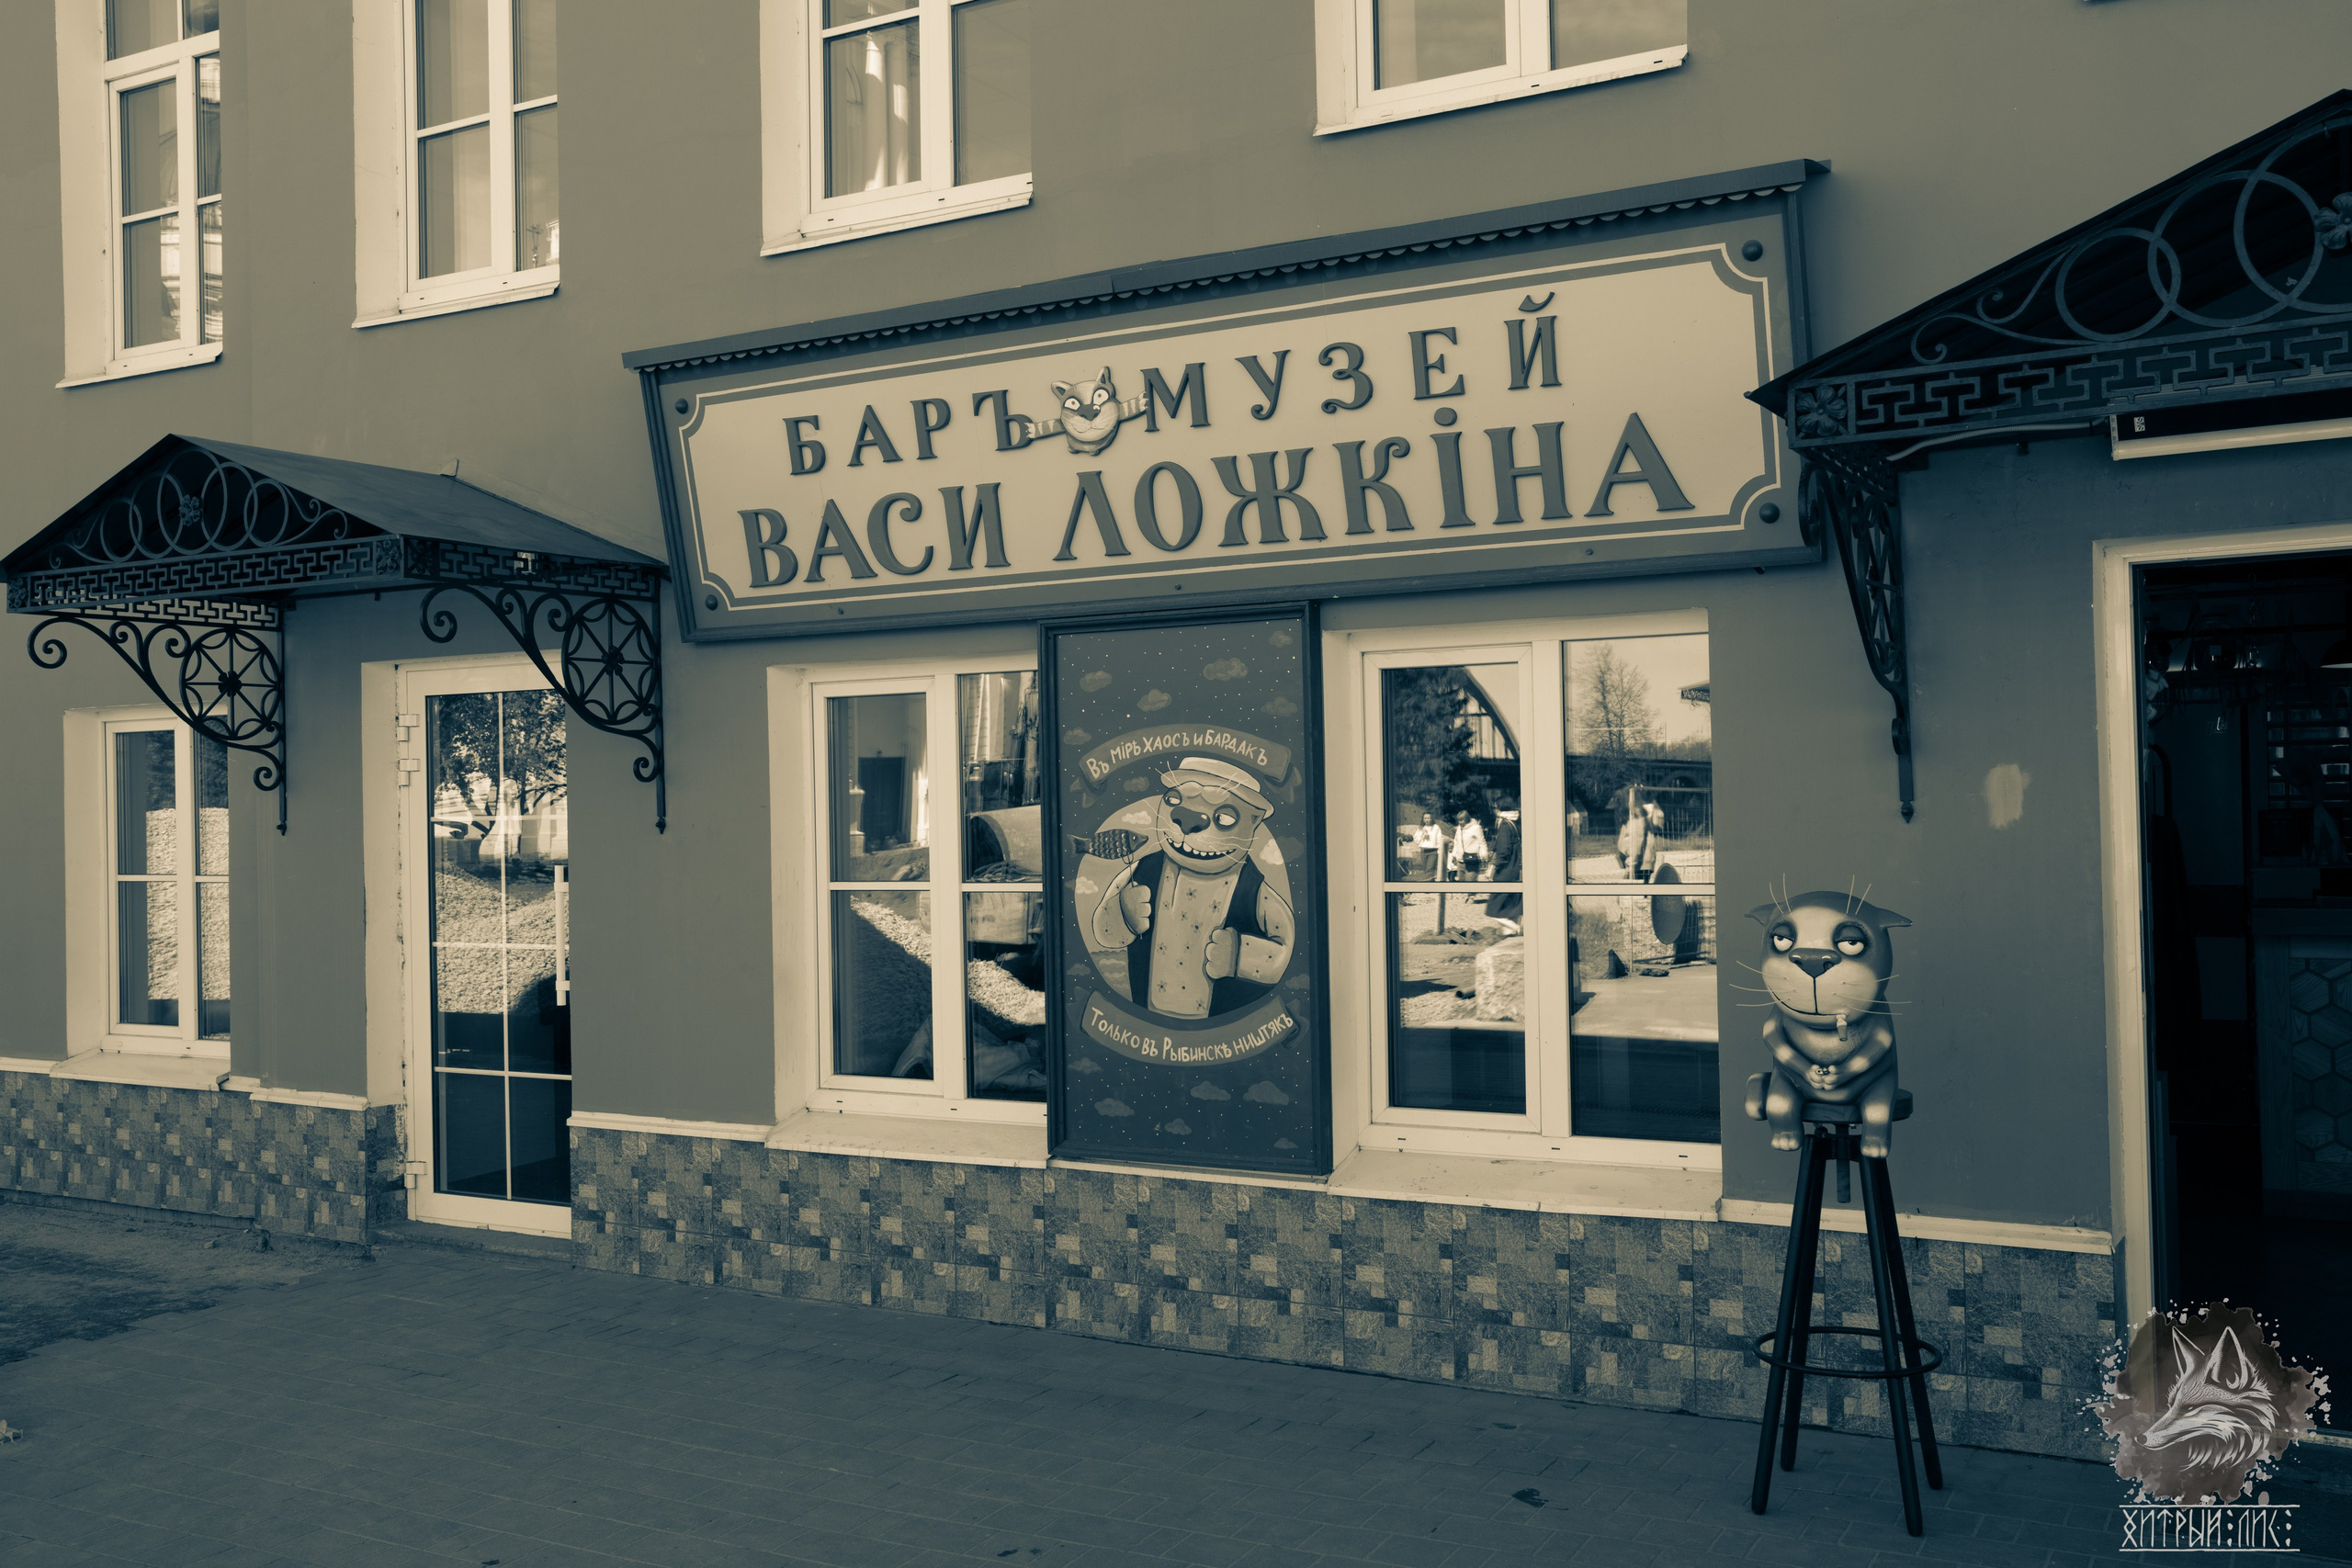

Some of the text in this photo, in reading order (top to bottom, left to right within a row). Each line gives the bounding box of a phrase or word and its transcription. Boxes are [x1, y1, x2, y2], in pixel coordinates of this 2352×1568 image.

[782, 291, 1564, 476] БАРЪ МУЗЕЙ
[737, 482, 1012, 588] ВАСИ
